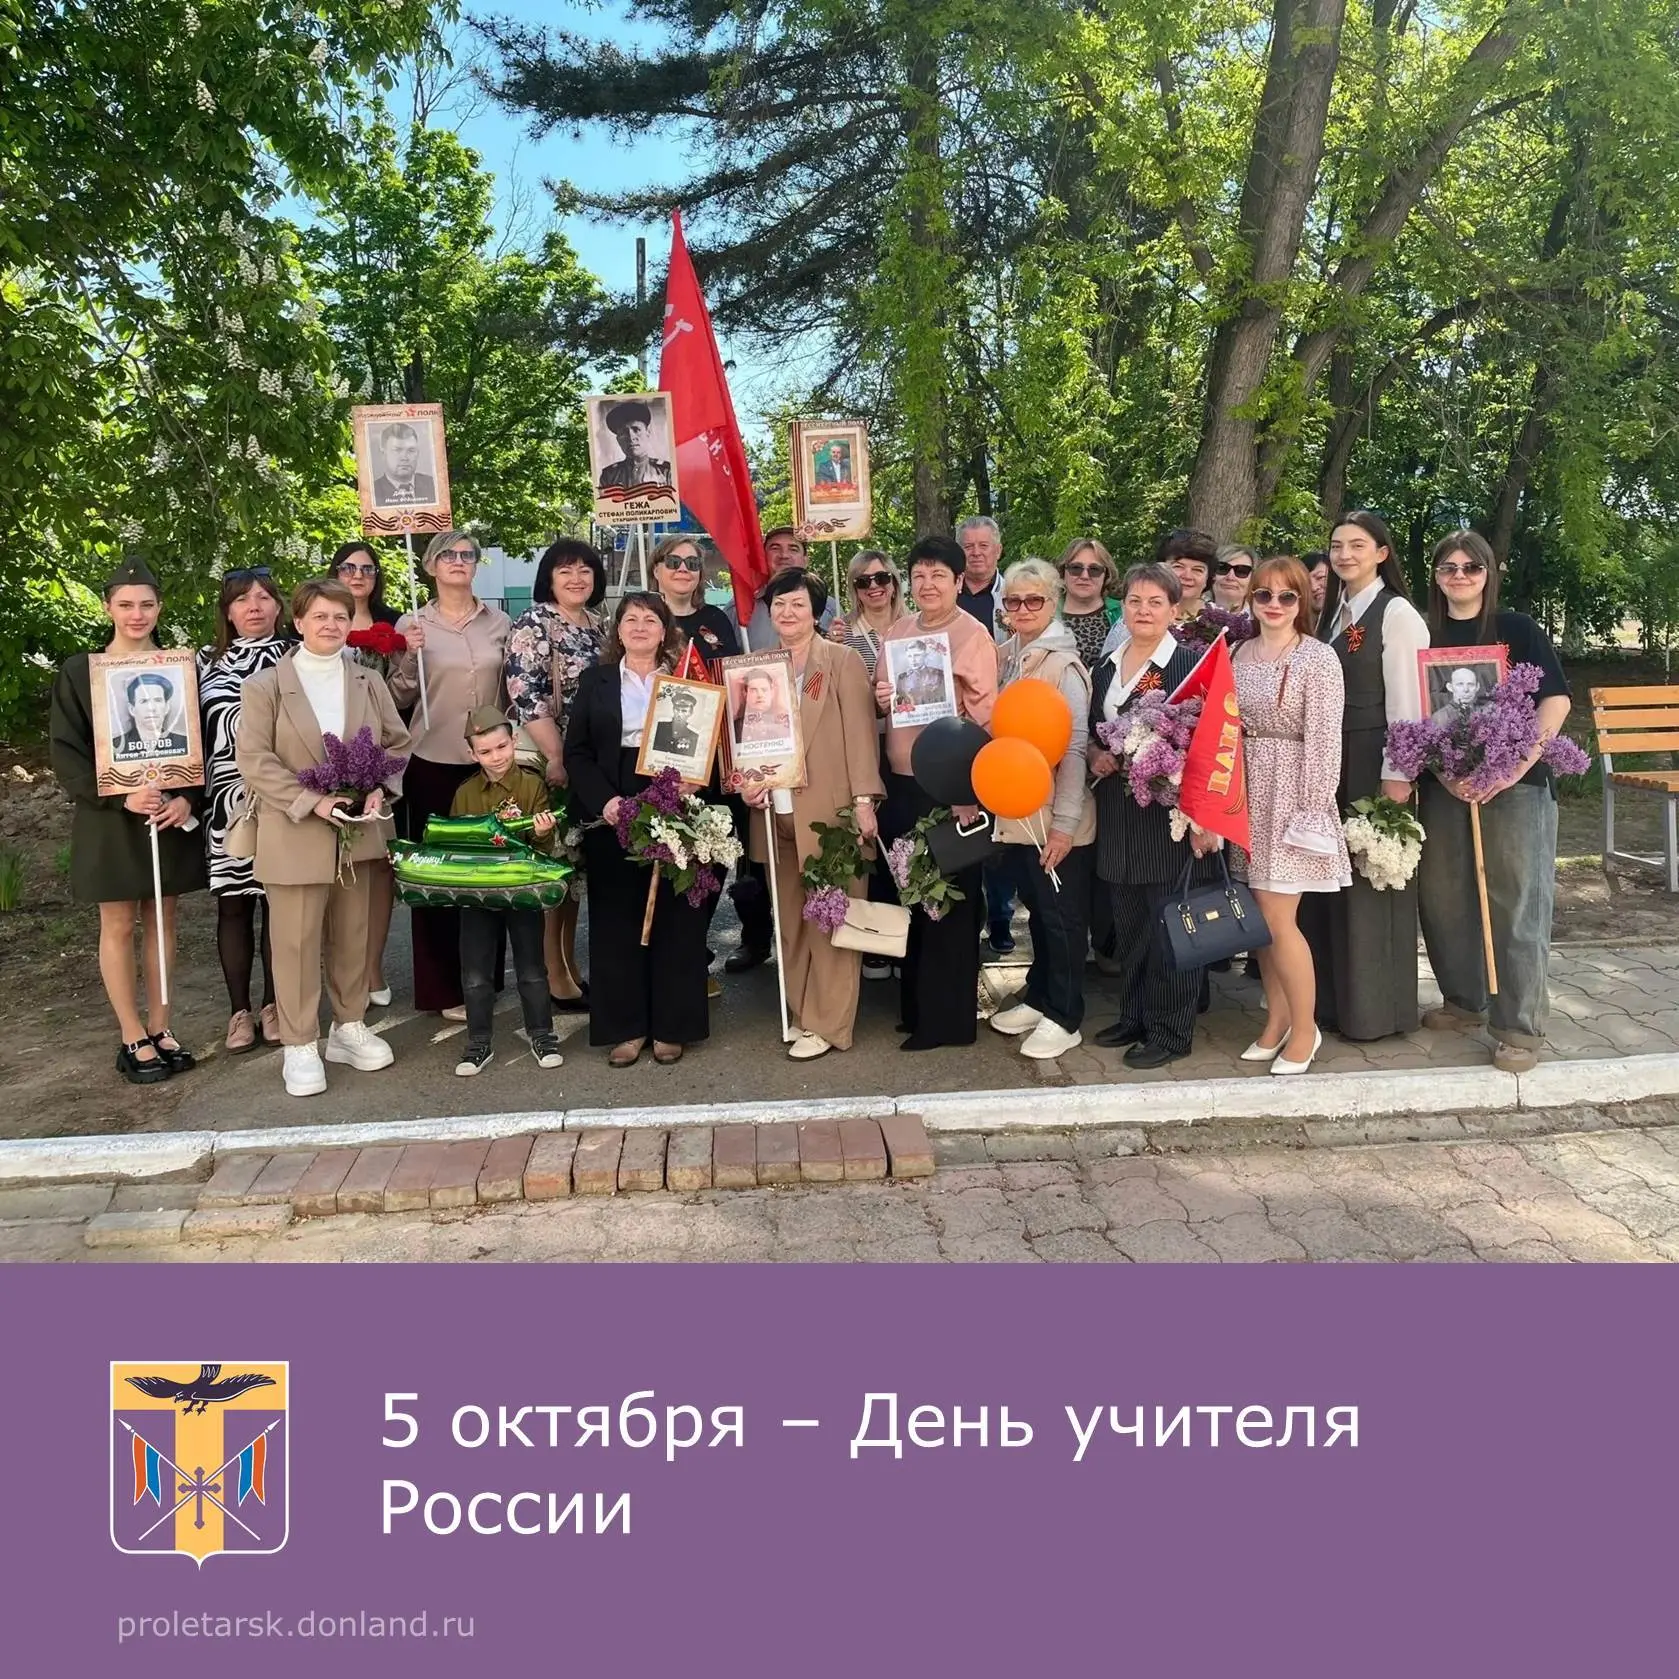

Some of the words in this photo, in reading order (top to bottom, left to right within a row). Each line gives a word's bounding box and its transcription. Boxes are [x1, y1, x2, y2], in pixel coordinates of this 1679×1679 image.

[624, 501, 650, 510] ГЕЖА
[625, 508, 678, 517] ПОЛИКАРПОВИЧ
[166, 654, 191, 663] ПОЛК
[128, 738, 173, 751] БОБРОВ
[139, 747, 186, 758] Трфонович
[408, 852, 446, 867] Родину!
